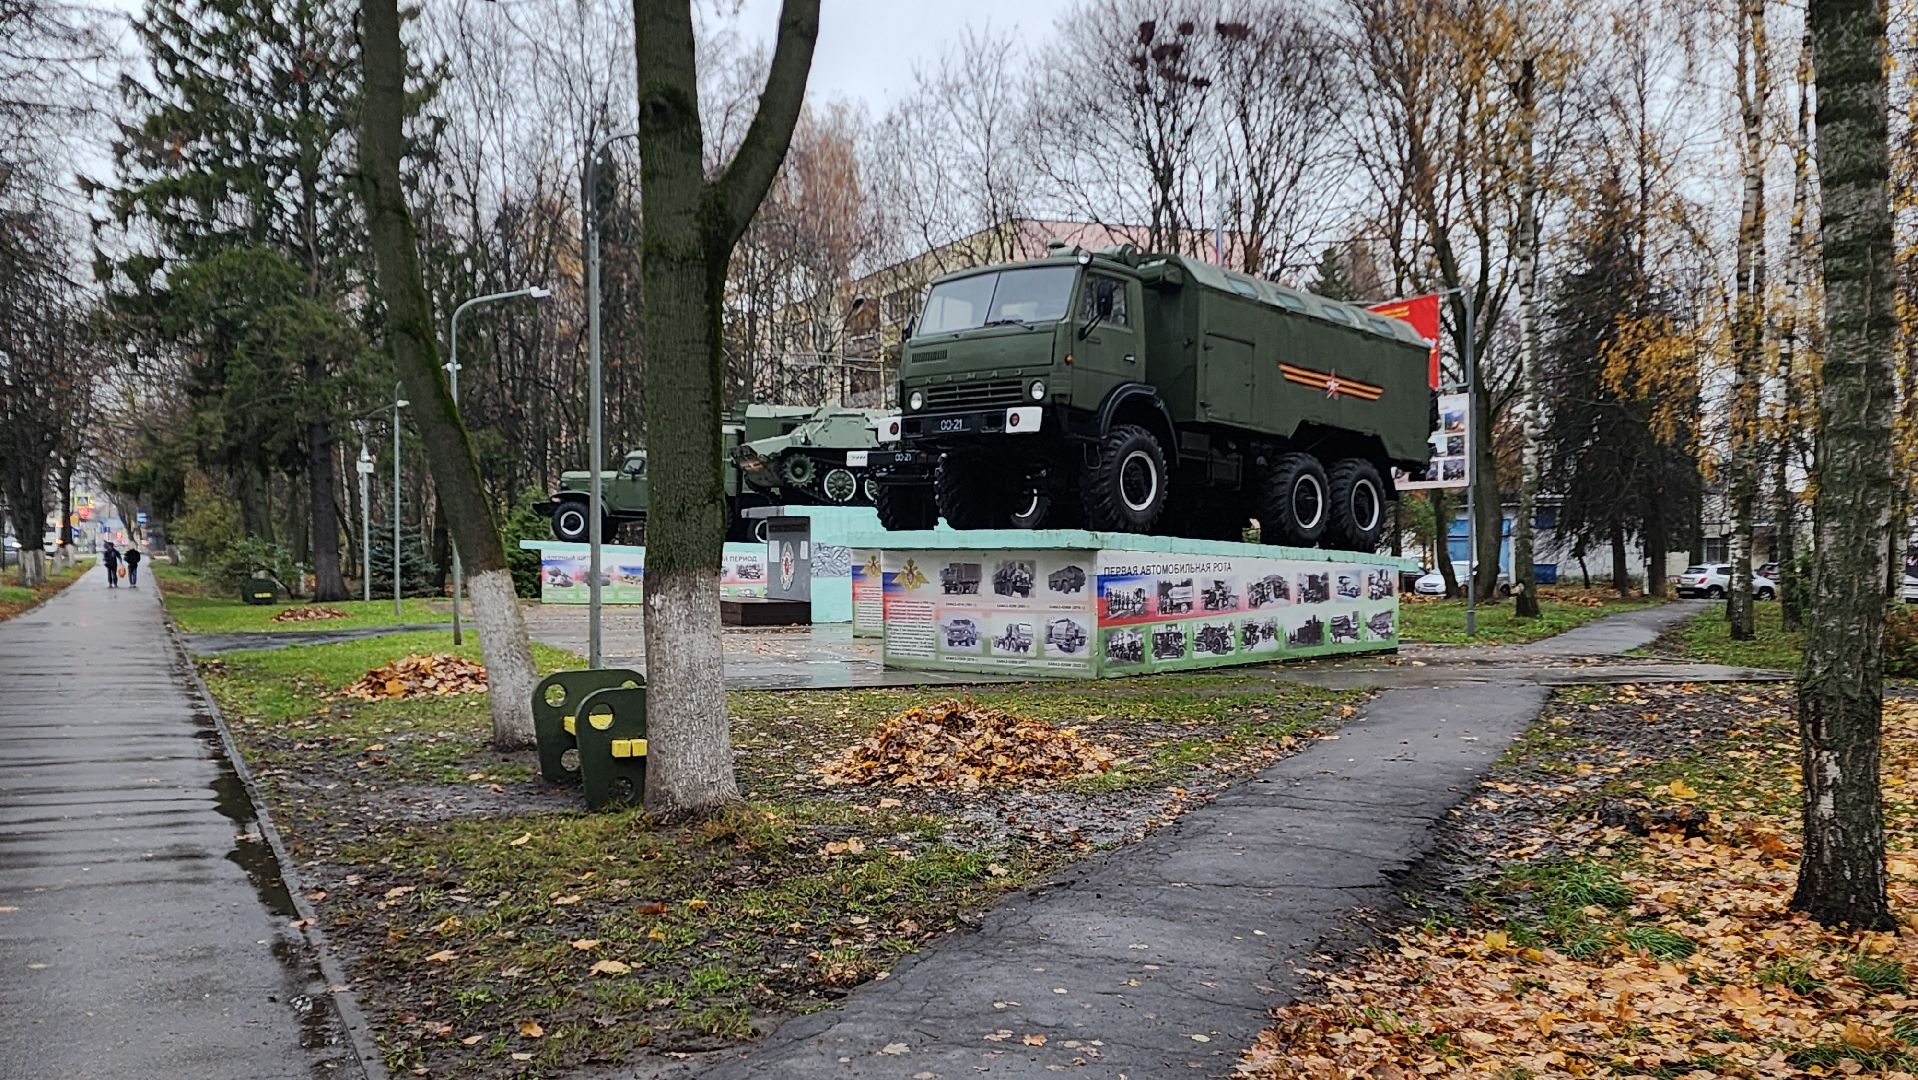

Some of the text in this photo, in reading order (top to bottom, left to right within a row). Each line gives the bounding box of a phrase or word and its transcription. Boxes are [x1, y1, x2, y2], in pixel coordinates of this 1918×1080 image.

[1103, 562, 1232, 577] ПЕРВАЯ АВТОМОБИЛЬНАЯ РОТА
